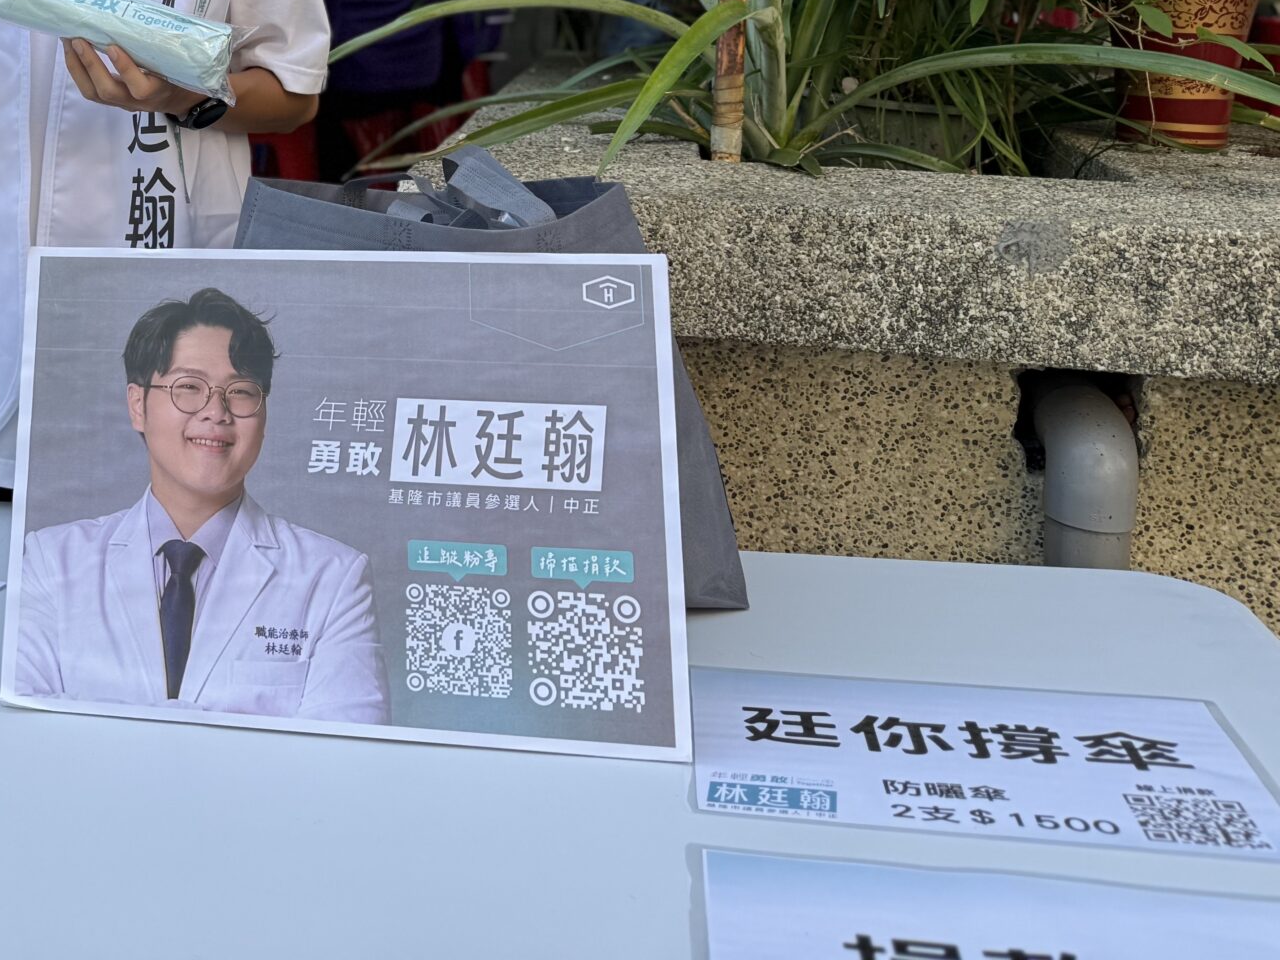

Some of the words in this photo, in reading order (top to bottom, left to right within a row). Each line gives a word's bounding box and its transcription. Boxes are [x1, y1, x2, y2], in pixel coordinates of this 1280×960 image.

[130, 8, 189, 34] Together
[312, 396, 387, 433] 年輕
[402, 403, 595, 484] 林廷翰
[307, 440, 383, 477] 勇敢
[416, 547, 498, 573] 追蹤粉專
[539, 551, 627, 578] 掃描捐款
[741, 706, 1195, 771] 廷你撐傘
[714, 783, 831, 811] 林廷翰
[882, 779, 1011, 801] 防曬傘
